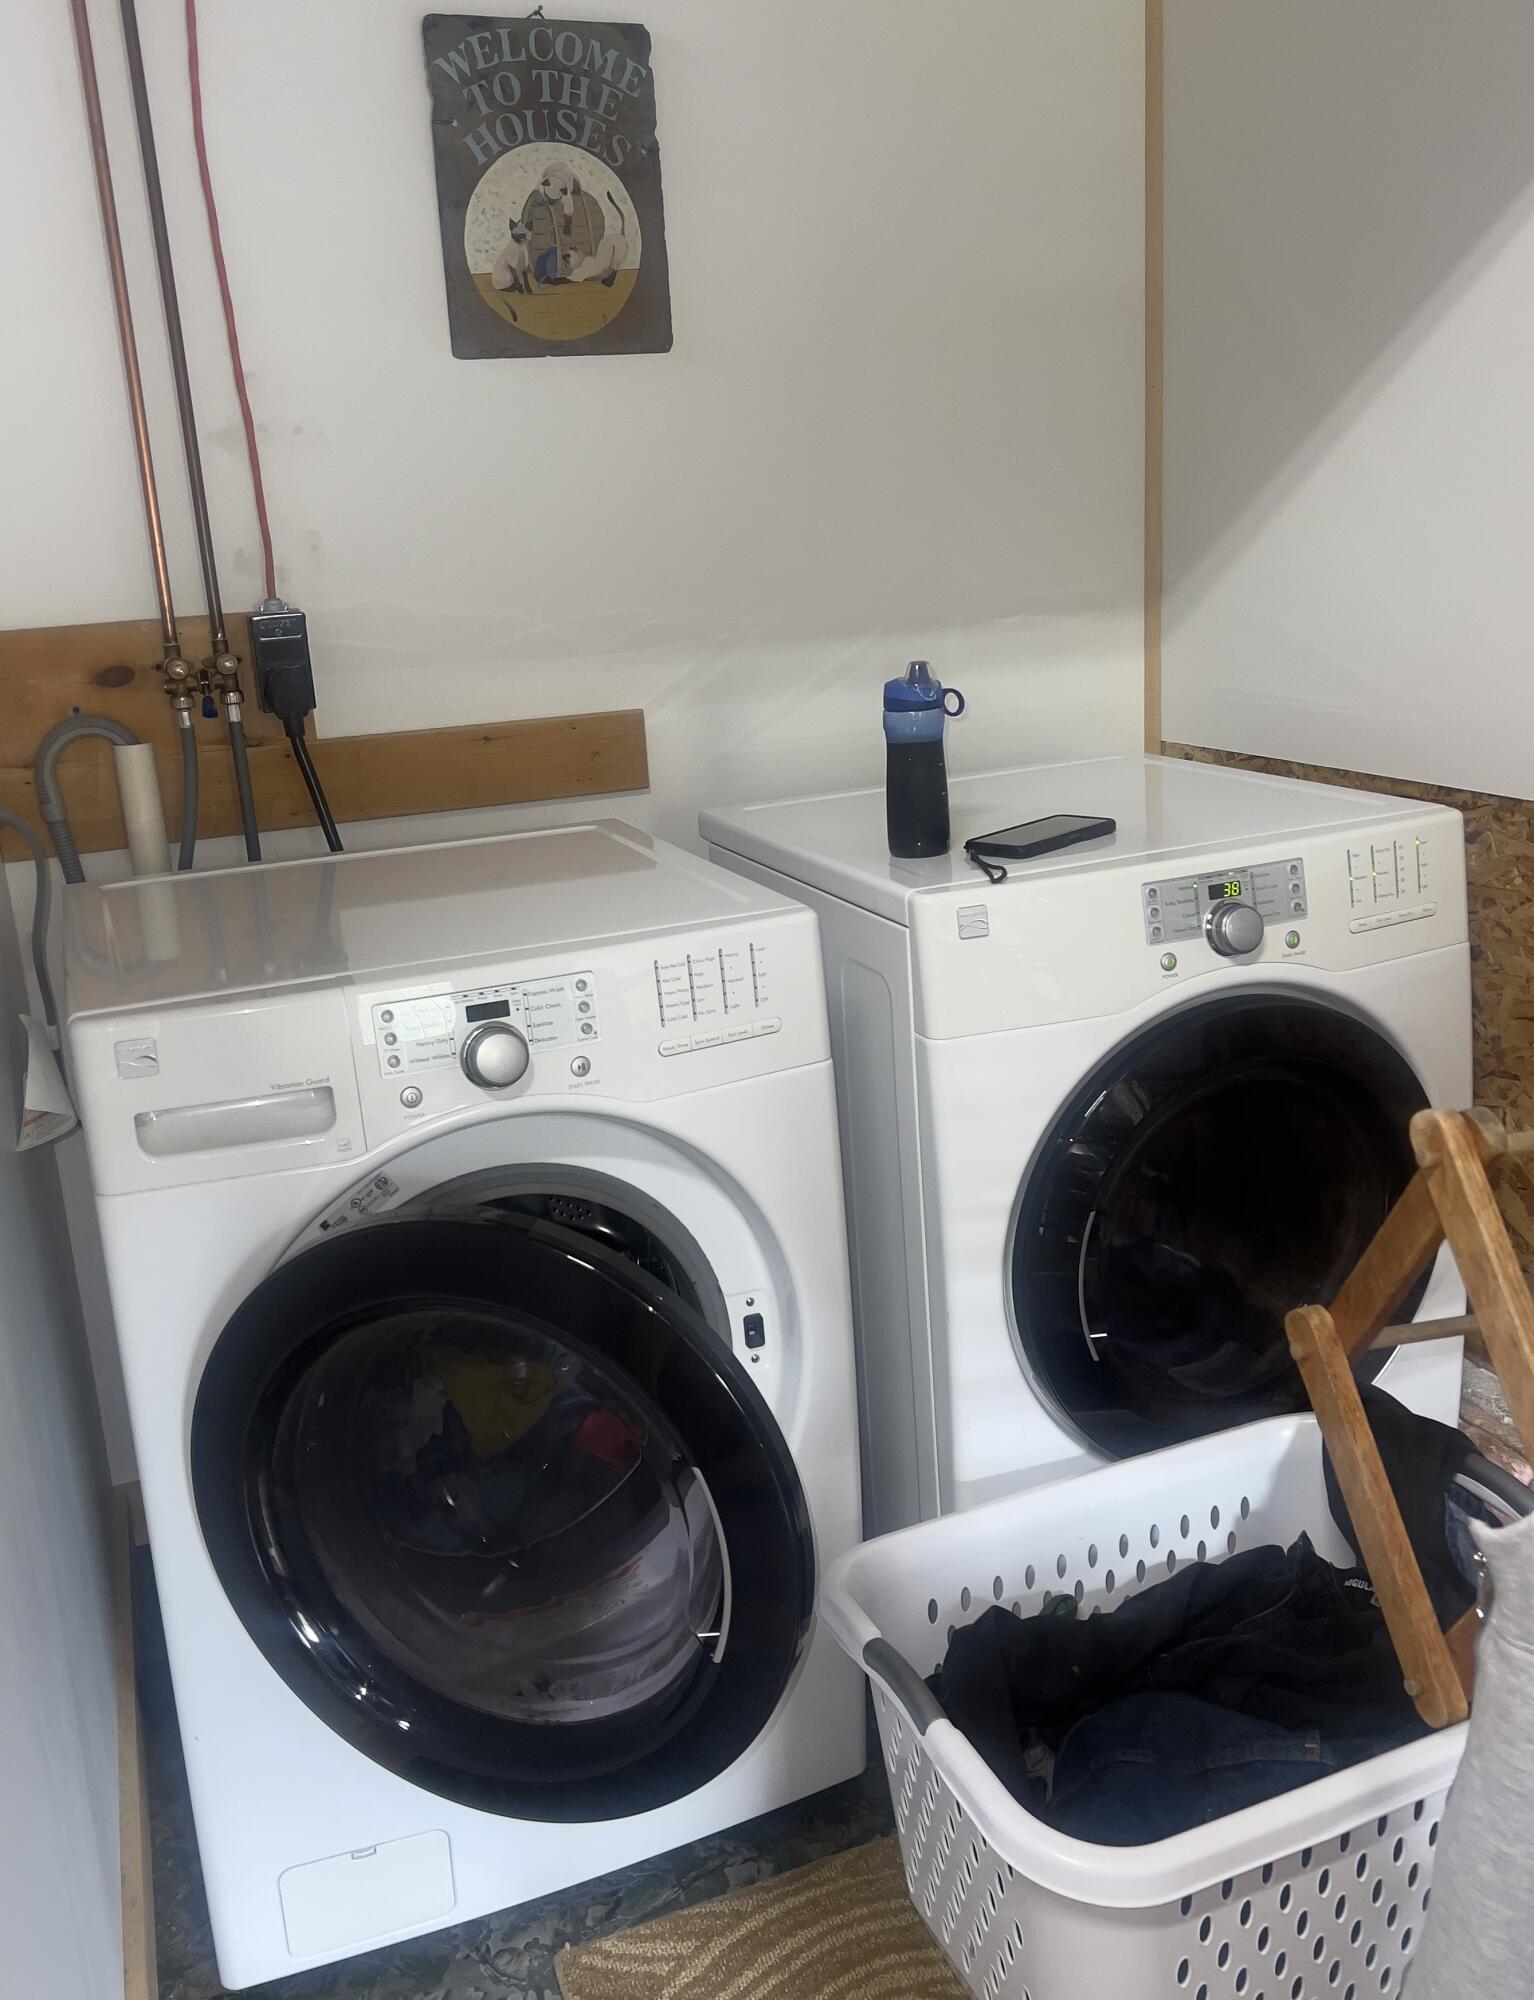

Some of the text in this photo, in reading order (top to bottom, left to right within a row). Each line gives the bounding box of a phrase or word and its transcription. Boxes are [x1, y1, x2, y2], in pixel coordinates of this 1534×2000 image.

[433, 26, 648, 98] WELCOME
[462, 69, 625, 122] TO THE
[462, 108, 632, 167] HOUSES
[1223, 881, 1240, 898] 38
[270, 1075, 330, 1091] Vibration Guard
